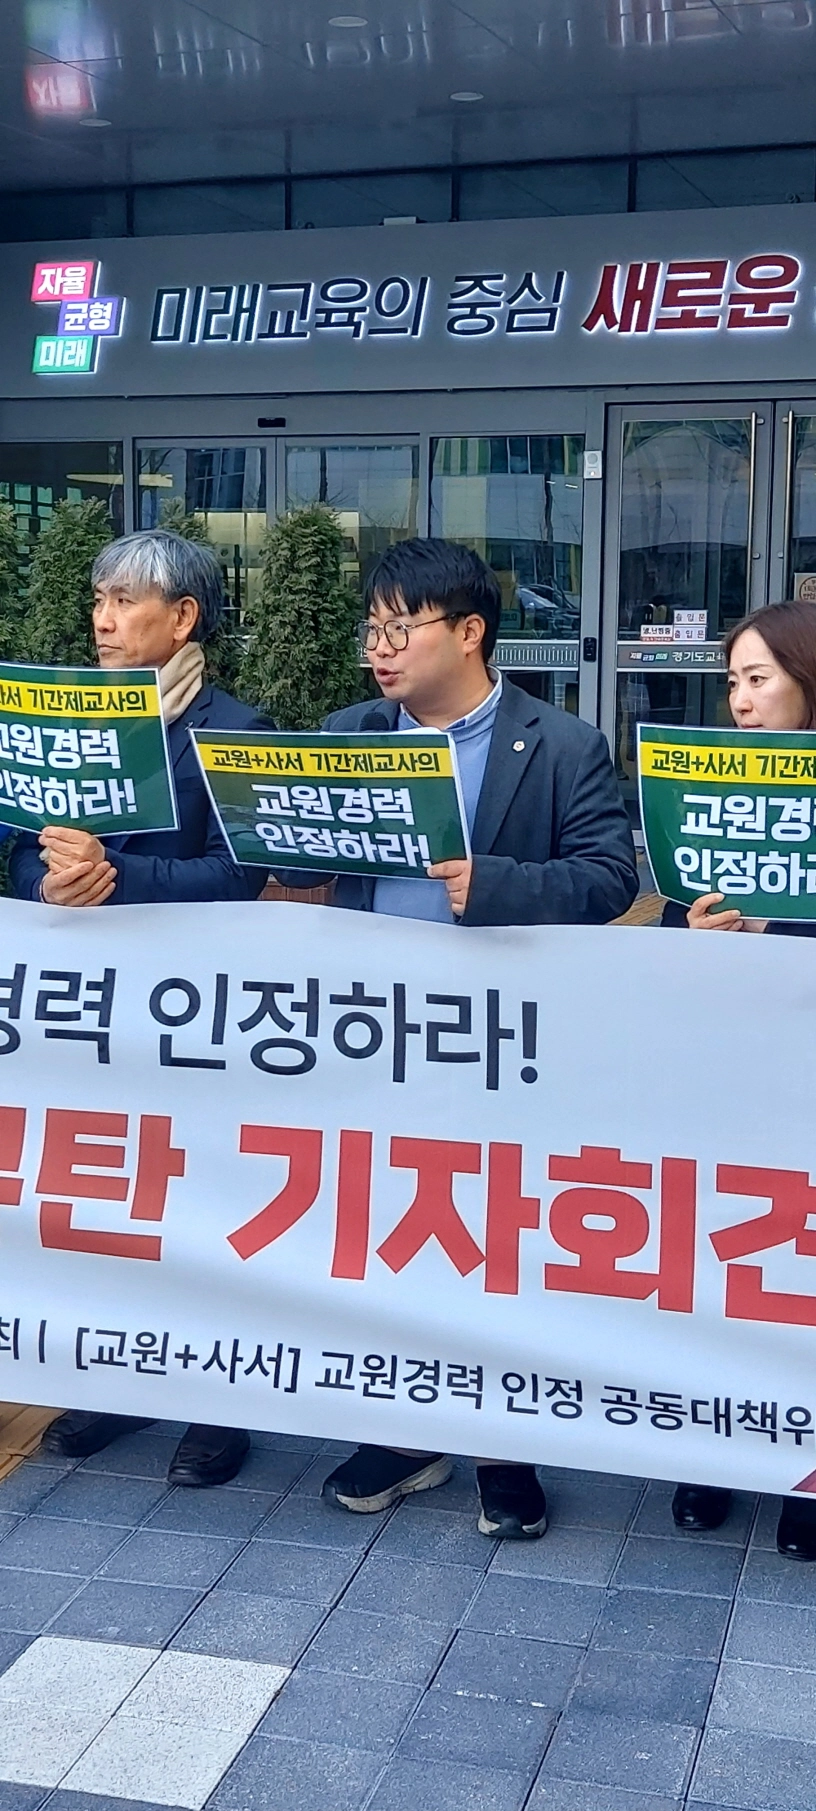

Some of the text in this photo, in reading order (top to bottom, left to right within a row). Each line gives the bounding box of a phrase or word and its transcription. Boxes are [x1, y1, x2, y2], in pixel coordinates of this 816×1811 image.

[37, 266, 87, 296] 자율
[150, 254, 801, 344] 미래교육의 중심 새로운
[64, 302, 113, 331] 균형
[39, 339, 88, 367] 미래
[27, 689, 147, 712] 기간제교사의
[211, 749, 441, 773] 교원+사서 기간제교사의
[651, 749, 747, 777] 교원+사서
[251, 784, 415, 826] 교원경력
[680, 794, 816, 842] 교원경
[255, 822, 431, 867] 인정하라!
[149, 973, 539, 1091] 인정하라!
[0, 1107, 186, 1262] 탄
[75, 1326, 301, 1394] [교원+사서]
[314, 1351, 484, 1410] 교원경력
[501, 1372, 584, 1419] 인정
